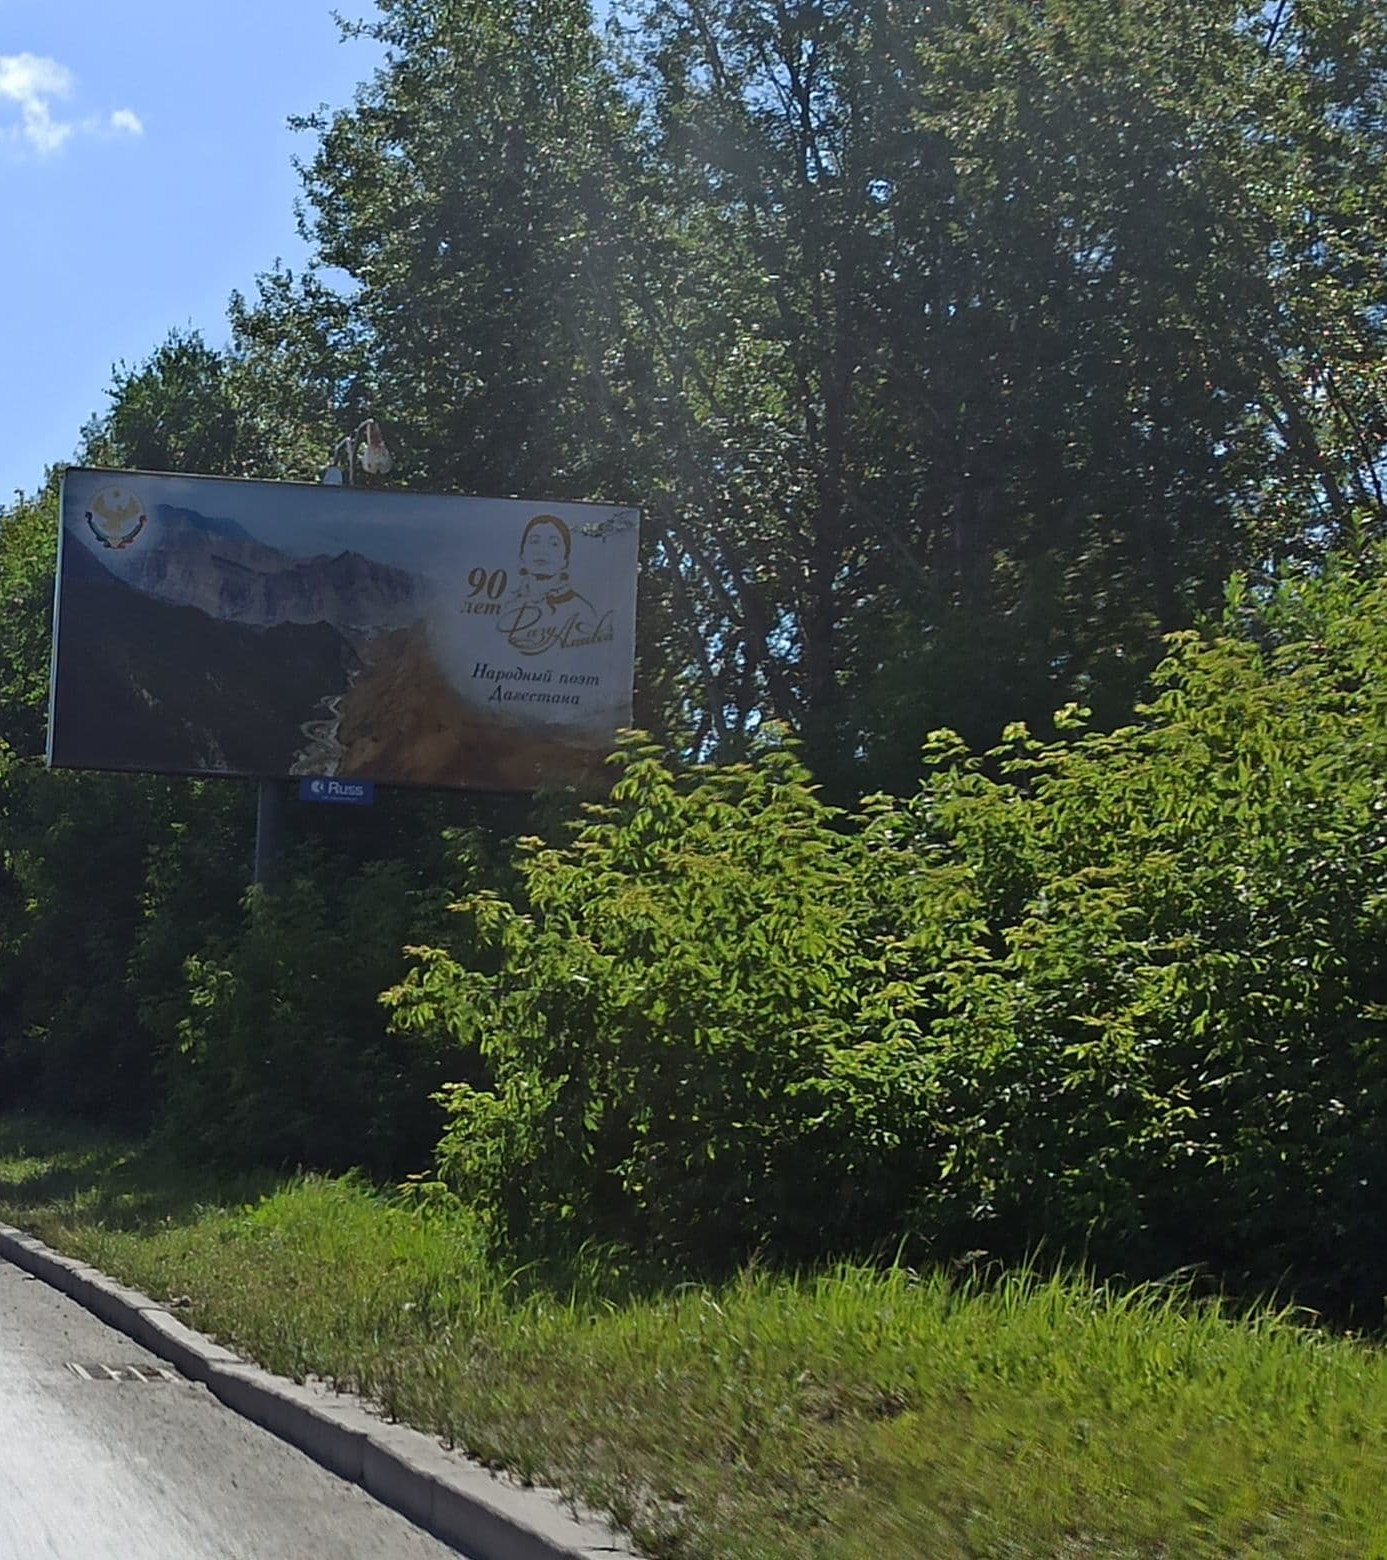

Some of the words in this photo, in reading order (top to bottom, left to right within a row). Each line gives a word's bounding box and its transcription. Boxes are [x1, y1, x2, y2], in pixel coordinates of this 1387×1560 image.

[468, 567, 508, 600] 90
[460, 602, 501, 615] лет
[471, 662, 552, 683] Народный
[558, 673, 600, 686] поэт
[489, 685, 580, 705] Дагестана
[327, 781, 364, 796] Russ
